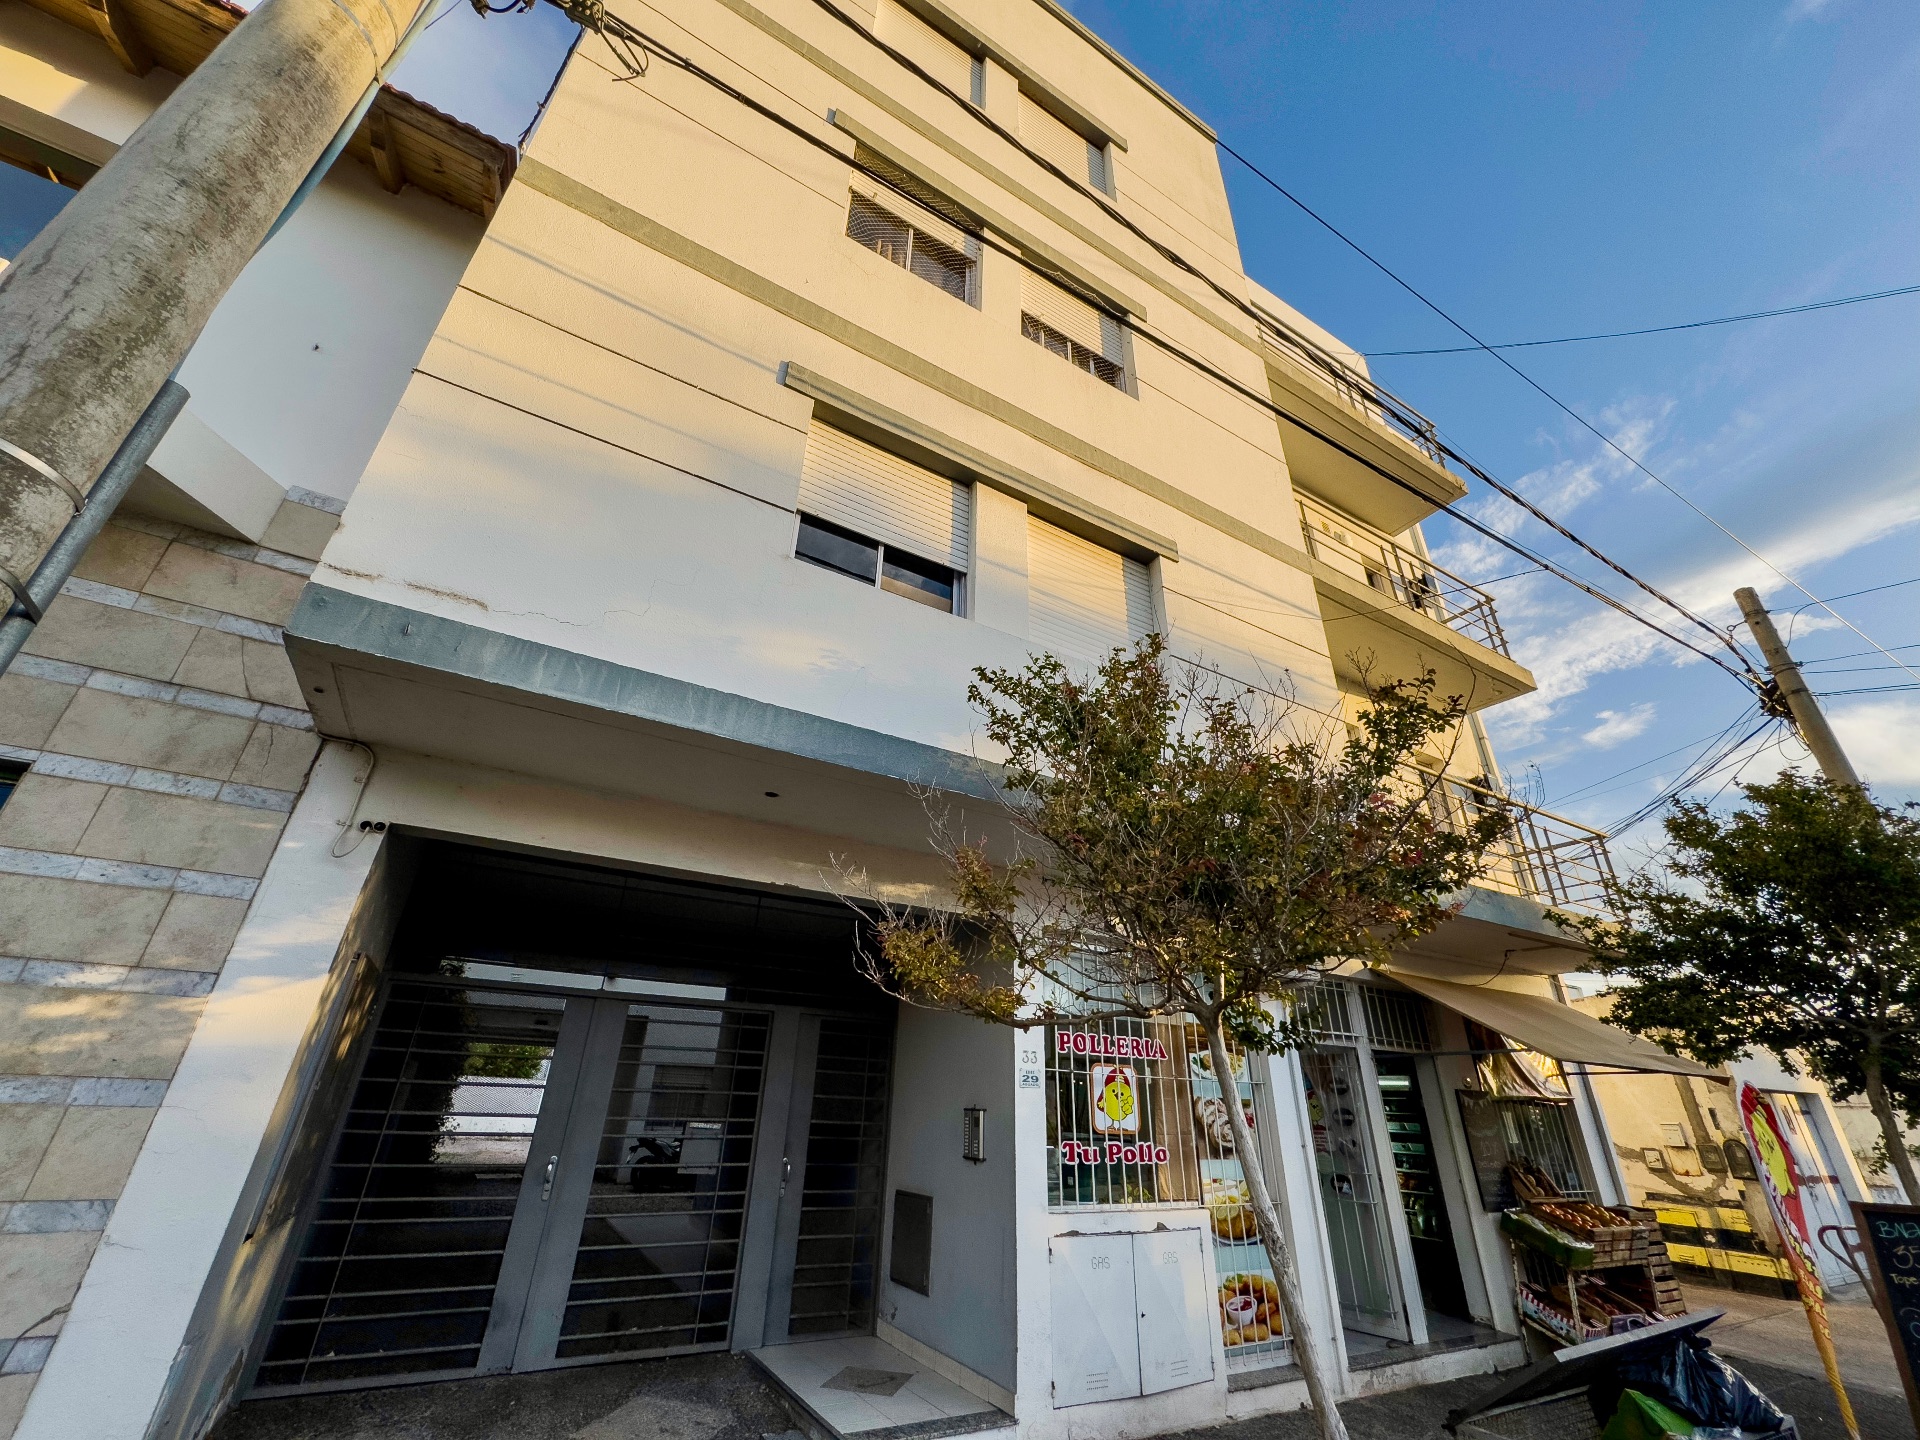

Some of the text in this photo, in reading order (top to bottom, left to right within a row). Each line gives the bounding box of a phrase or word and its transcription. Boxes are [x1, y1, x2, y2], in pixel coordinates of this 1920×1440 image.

[1057, 1031, 1168, 1060] POLLERIA
[1022, 1050, 1038, 1064] 33
[1022, 1074, 1039, 1083] 29
[1061, 1140, 1169, 1165] Tu Pollo
[1091, 1256, 1111, 1270] GAS
[1162, 1251, 1178, 1265] GAS
